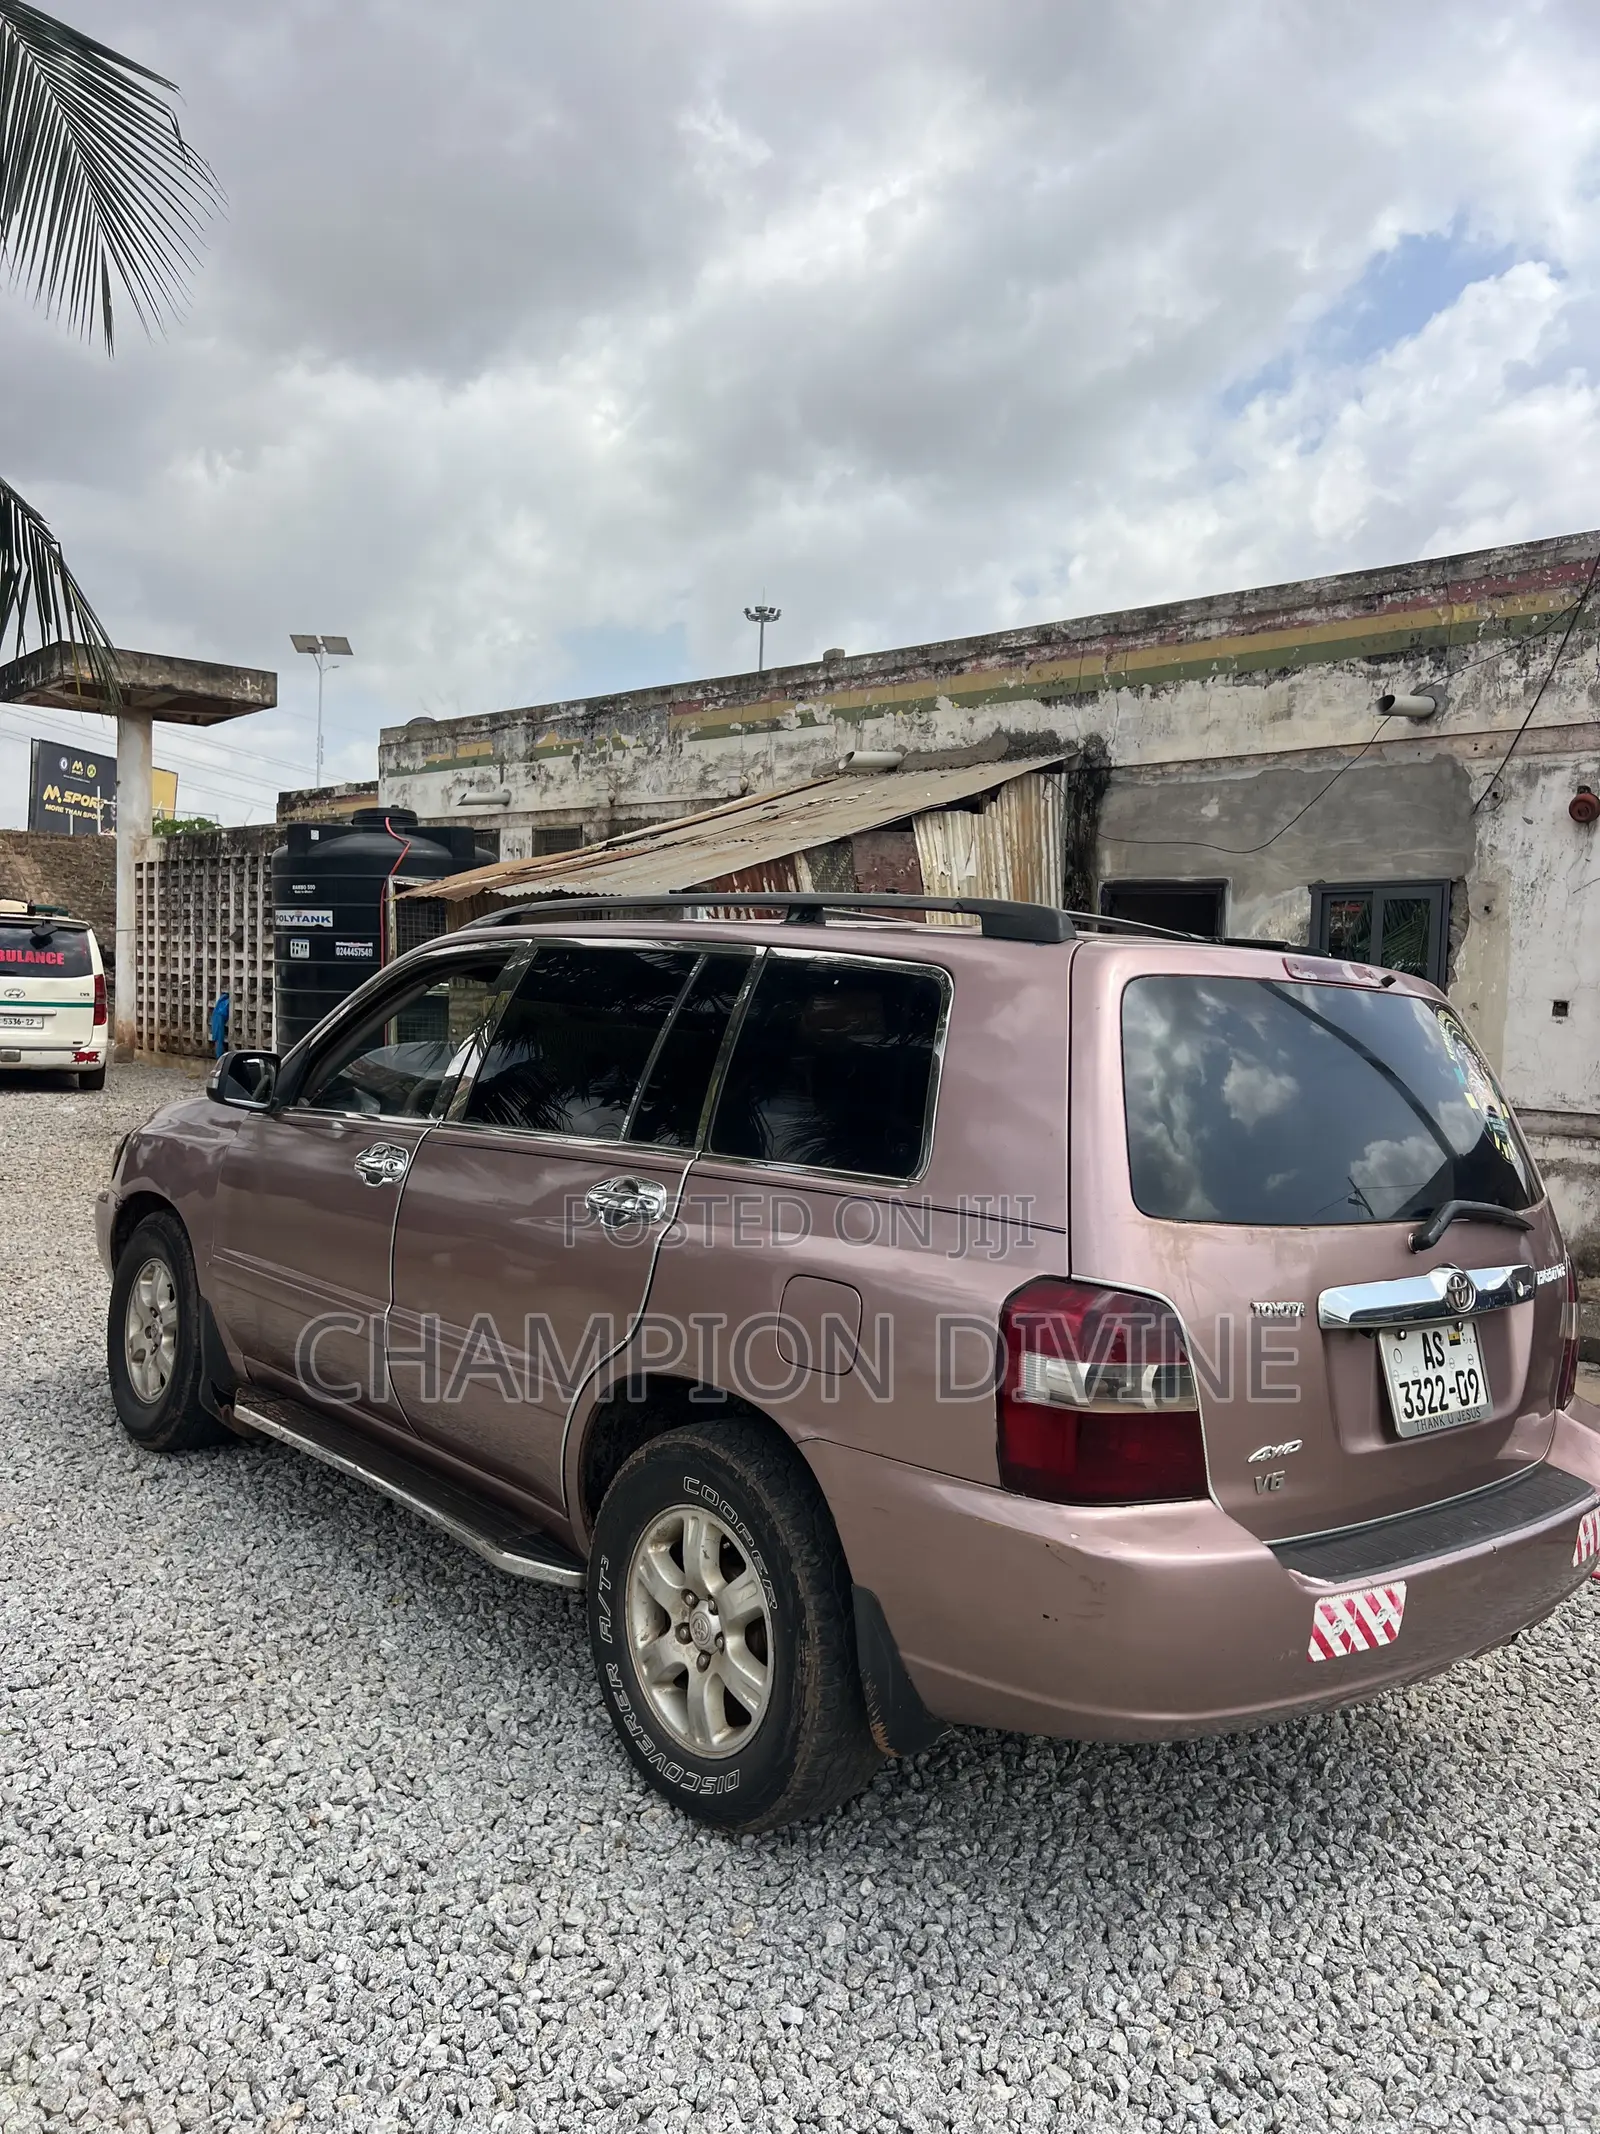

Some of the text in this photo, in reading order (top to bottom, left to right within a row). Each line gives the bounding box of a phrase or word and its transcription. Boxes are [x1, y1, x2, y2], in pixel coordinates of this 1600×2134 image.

[45, 804, 64, 813] MORE
[65, 807, 82, 817] THAN
[276, 915, 331, 923] POLYTANK
[1250, 1301, 1306, 1318] TOYOTA
[1422, 1331, 1445, 1370] AS
[1399, 1368, 1480, 1419] 3322-09
[1415, 1406, 1482, 1432] THANK U JESUS
[1254, 1470, 1286, 1495] V6
[683, 1476, 778, 1611] COOPER
[605, 1662, 740, 1795] DISCOVERER
